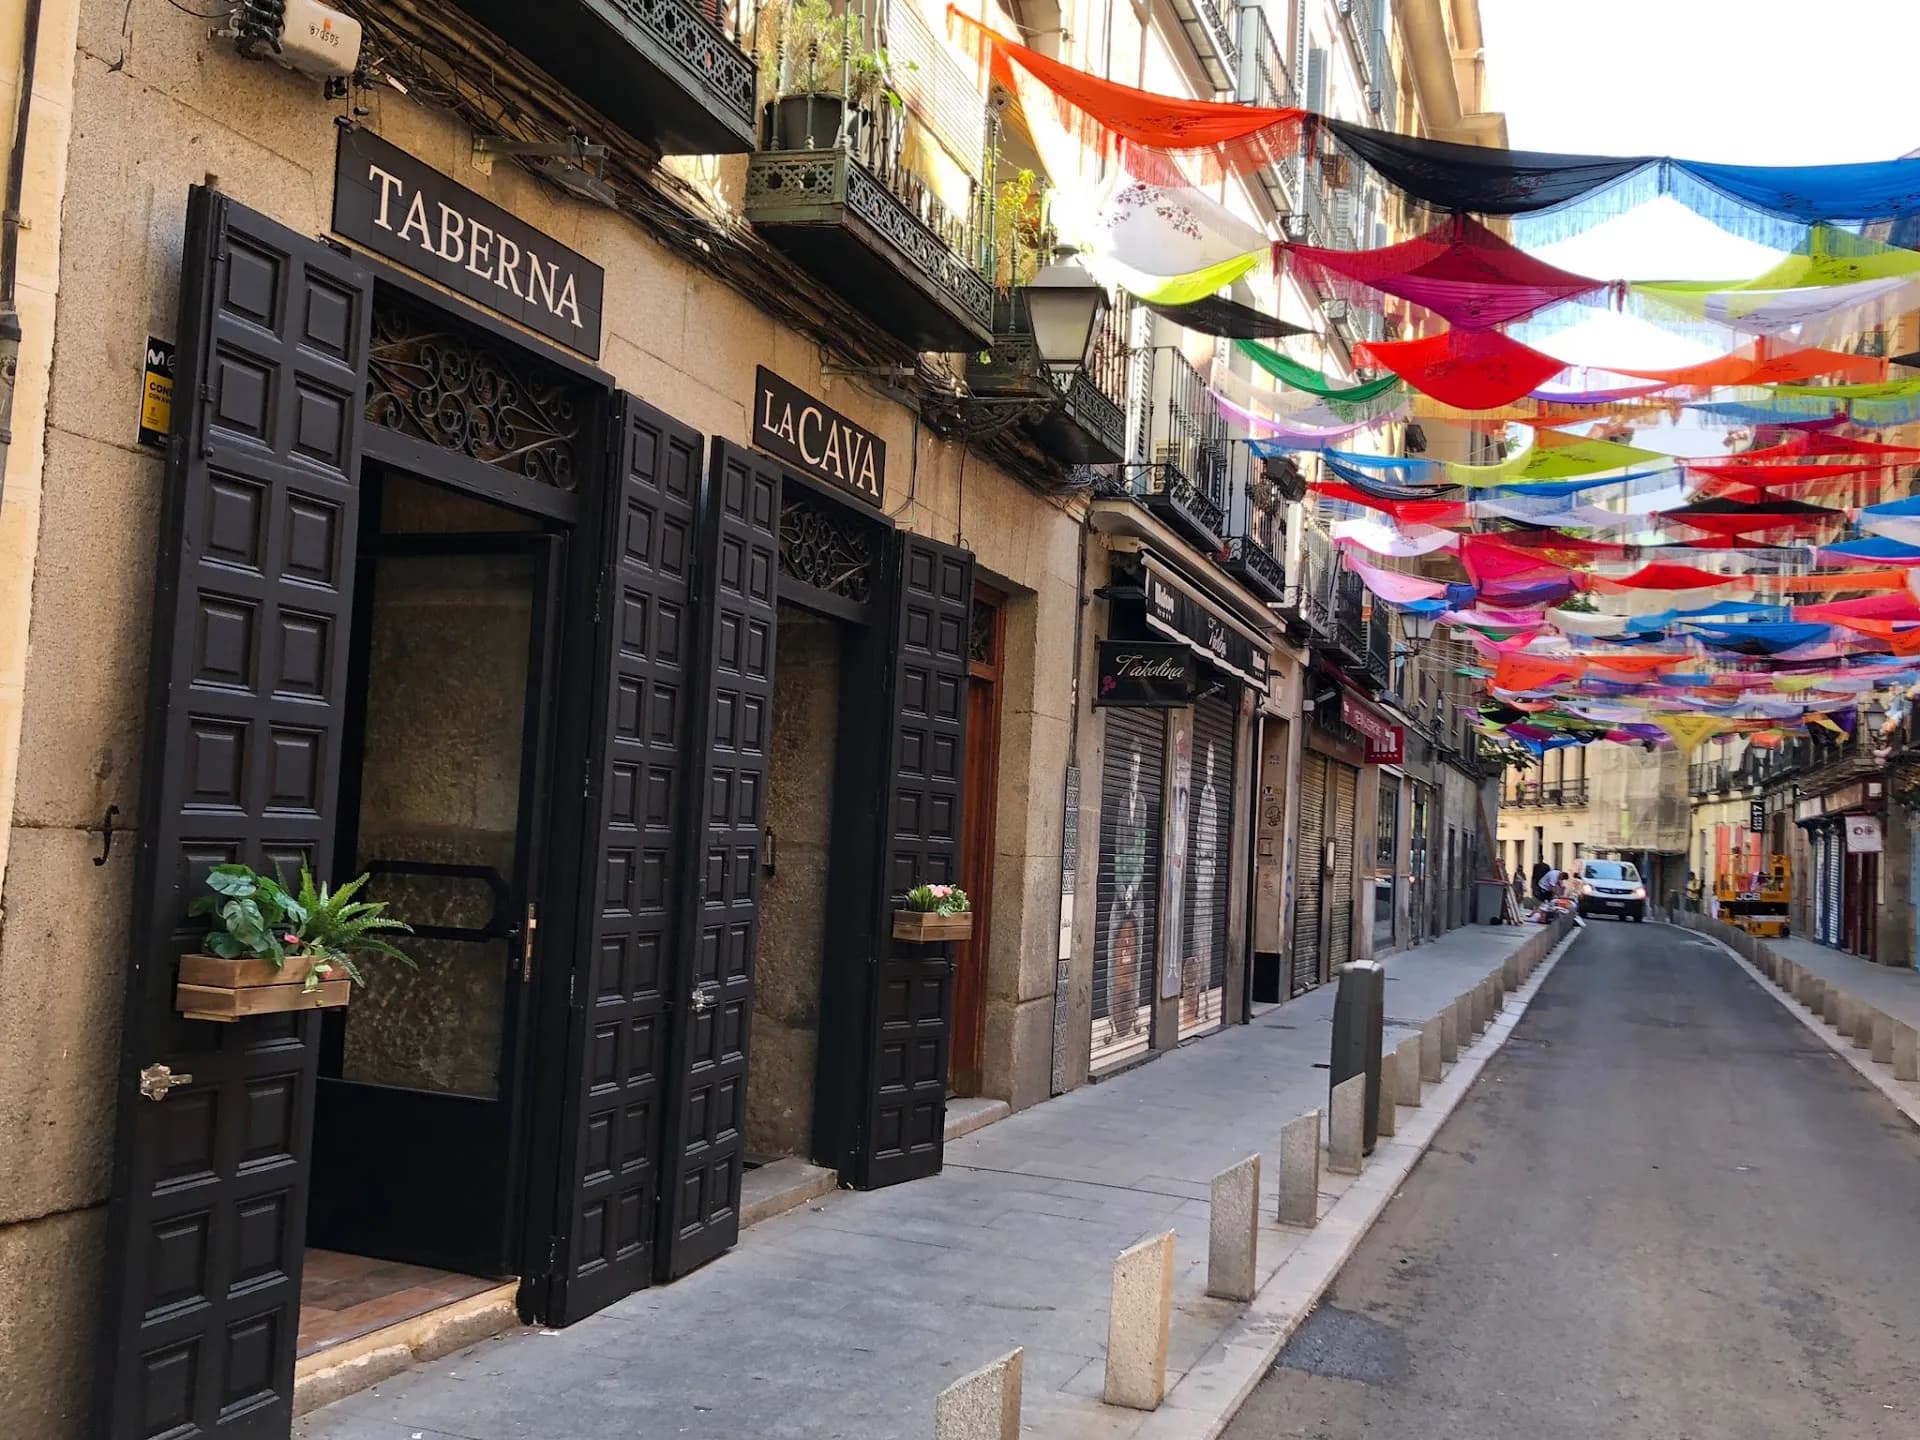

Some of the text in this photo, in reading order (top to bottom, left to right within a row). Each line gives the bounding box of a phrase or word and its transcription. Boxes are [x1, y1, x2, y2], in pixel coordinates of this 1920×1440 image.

[368, 163, 584, 328] TABERNA
[1115, 654, 1185, 680] Takolina
[1736, 892, 1761, 901] JCB
